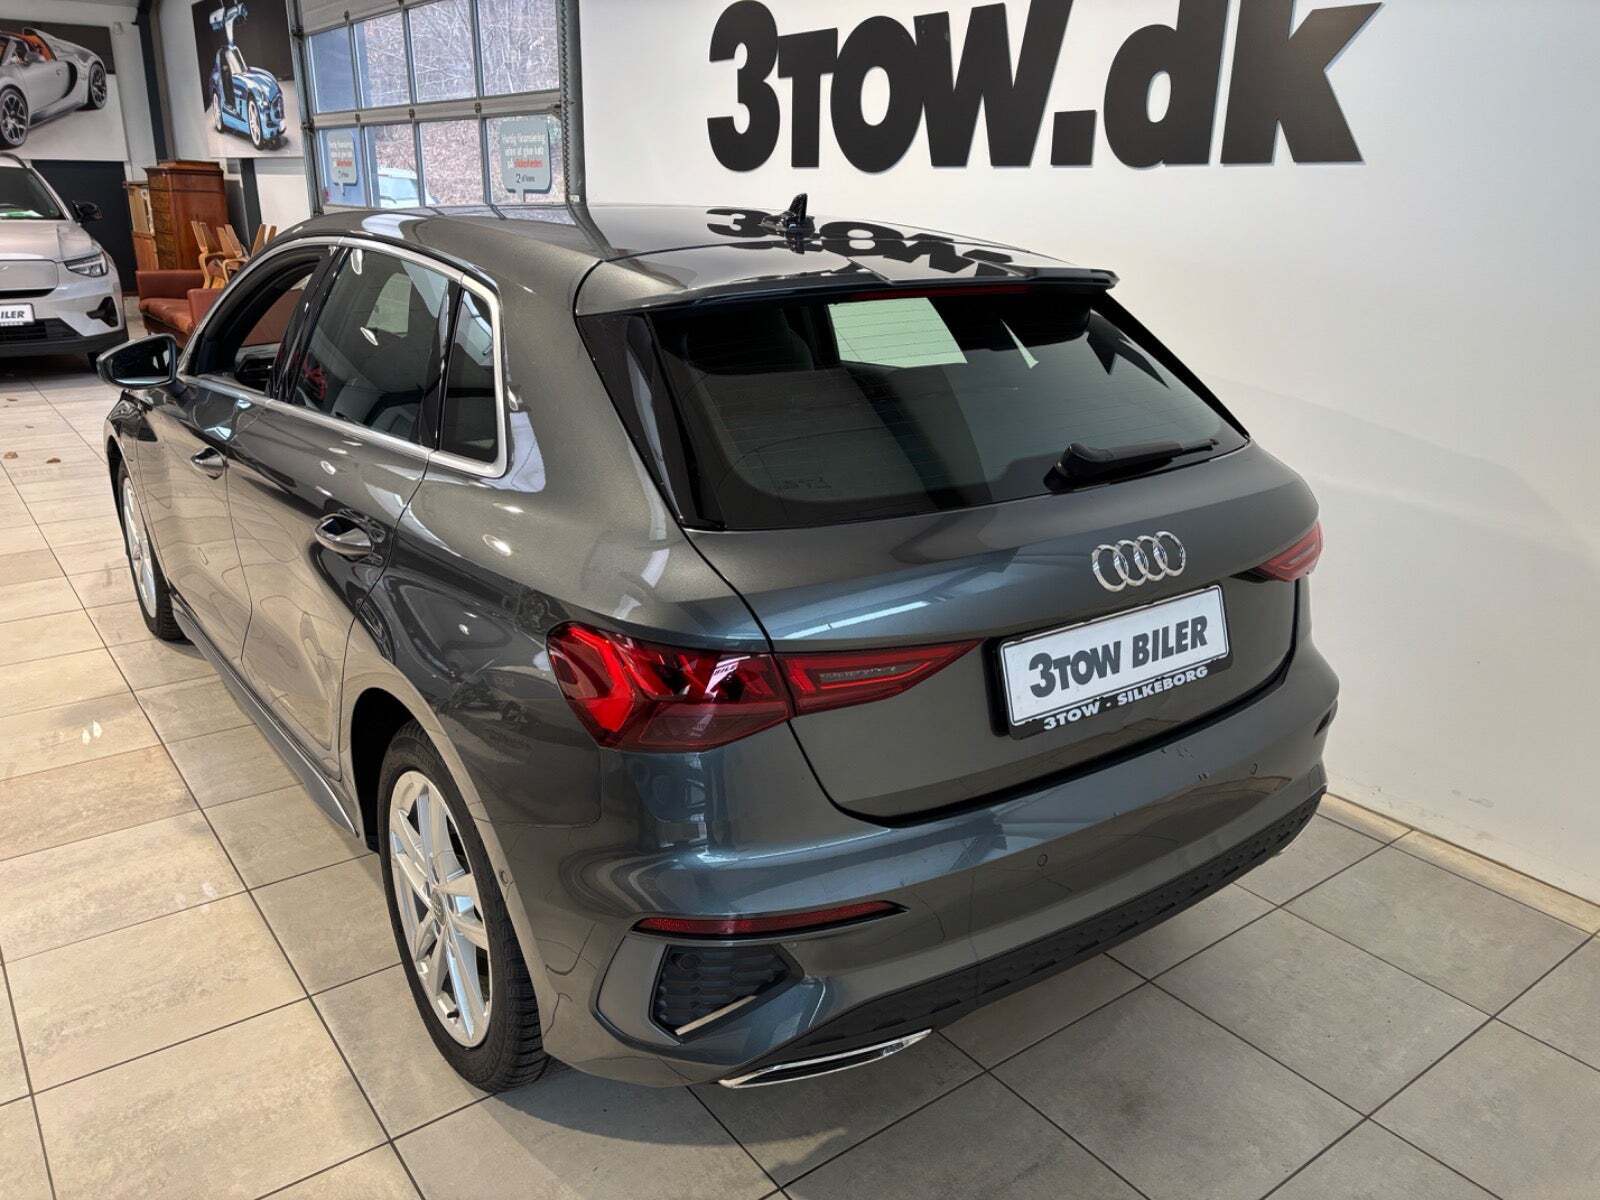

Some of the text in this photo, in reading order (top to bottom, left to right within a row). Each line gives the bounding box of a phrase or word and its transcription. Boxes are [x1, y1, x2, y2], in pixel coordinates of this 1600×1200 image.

[1028, 615, 1208, 698] 3TOW BILER
[1043, 666, 1208, 730] 3TOW SILKEBORG
